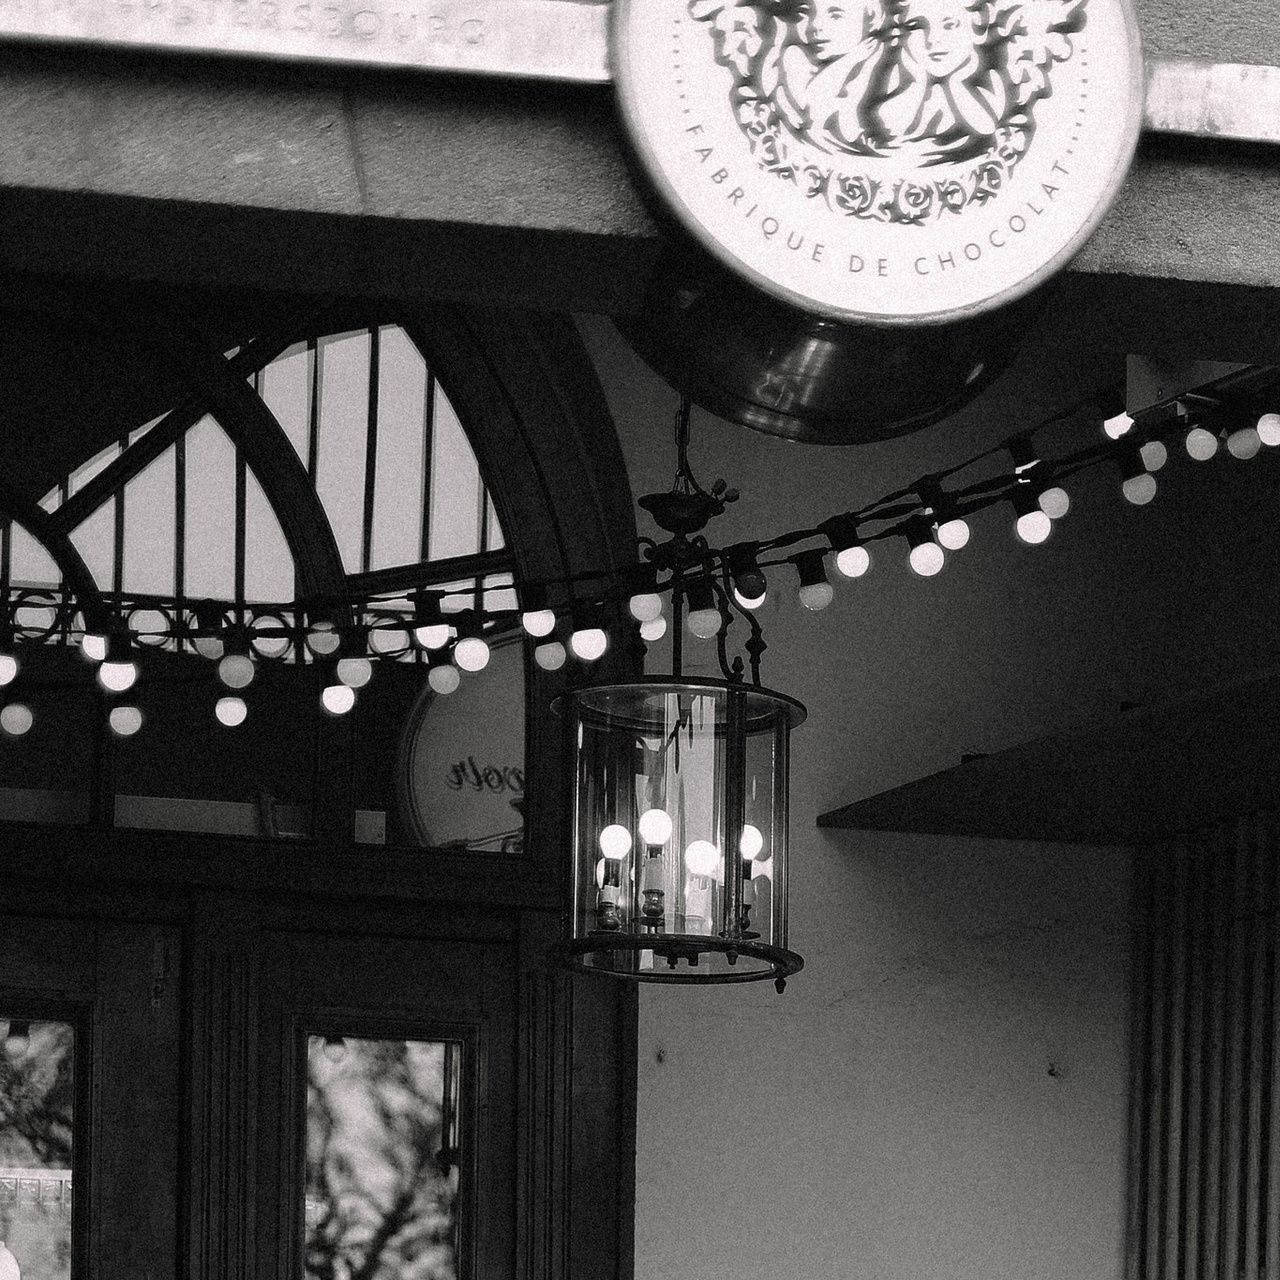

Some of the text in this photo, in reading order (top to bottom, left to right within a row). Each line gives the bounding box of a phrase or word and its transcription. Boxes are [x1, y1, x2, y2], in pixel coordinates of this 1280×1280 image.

[685, 124, 1069, 277] FABRIQUE DE CHOCOLAT
